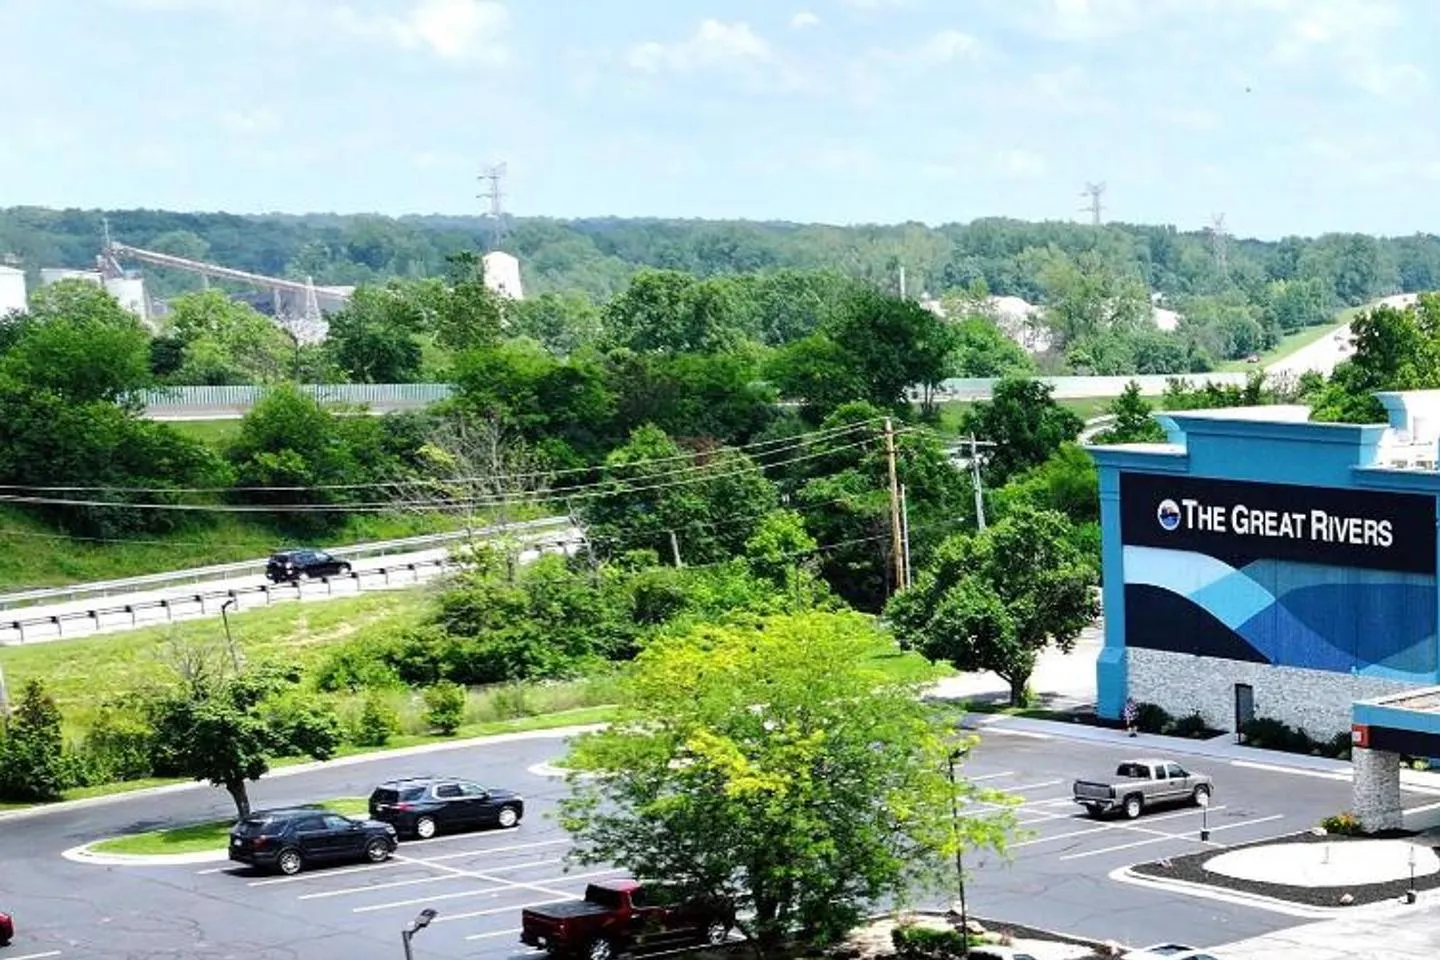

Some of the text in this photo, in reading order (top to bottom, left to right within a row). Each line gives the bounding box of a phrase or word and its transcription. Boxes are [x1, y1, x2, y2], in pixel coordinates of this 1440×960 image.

[1182, 499, 1393, 547] THE GREAT RIVERS
